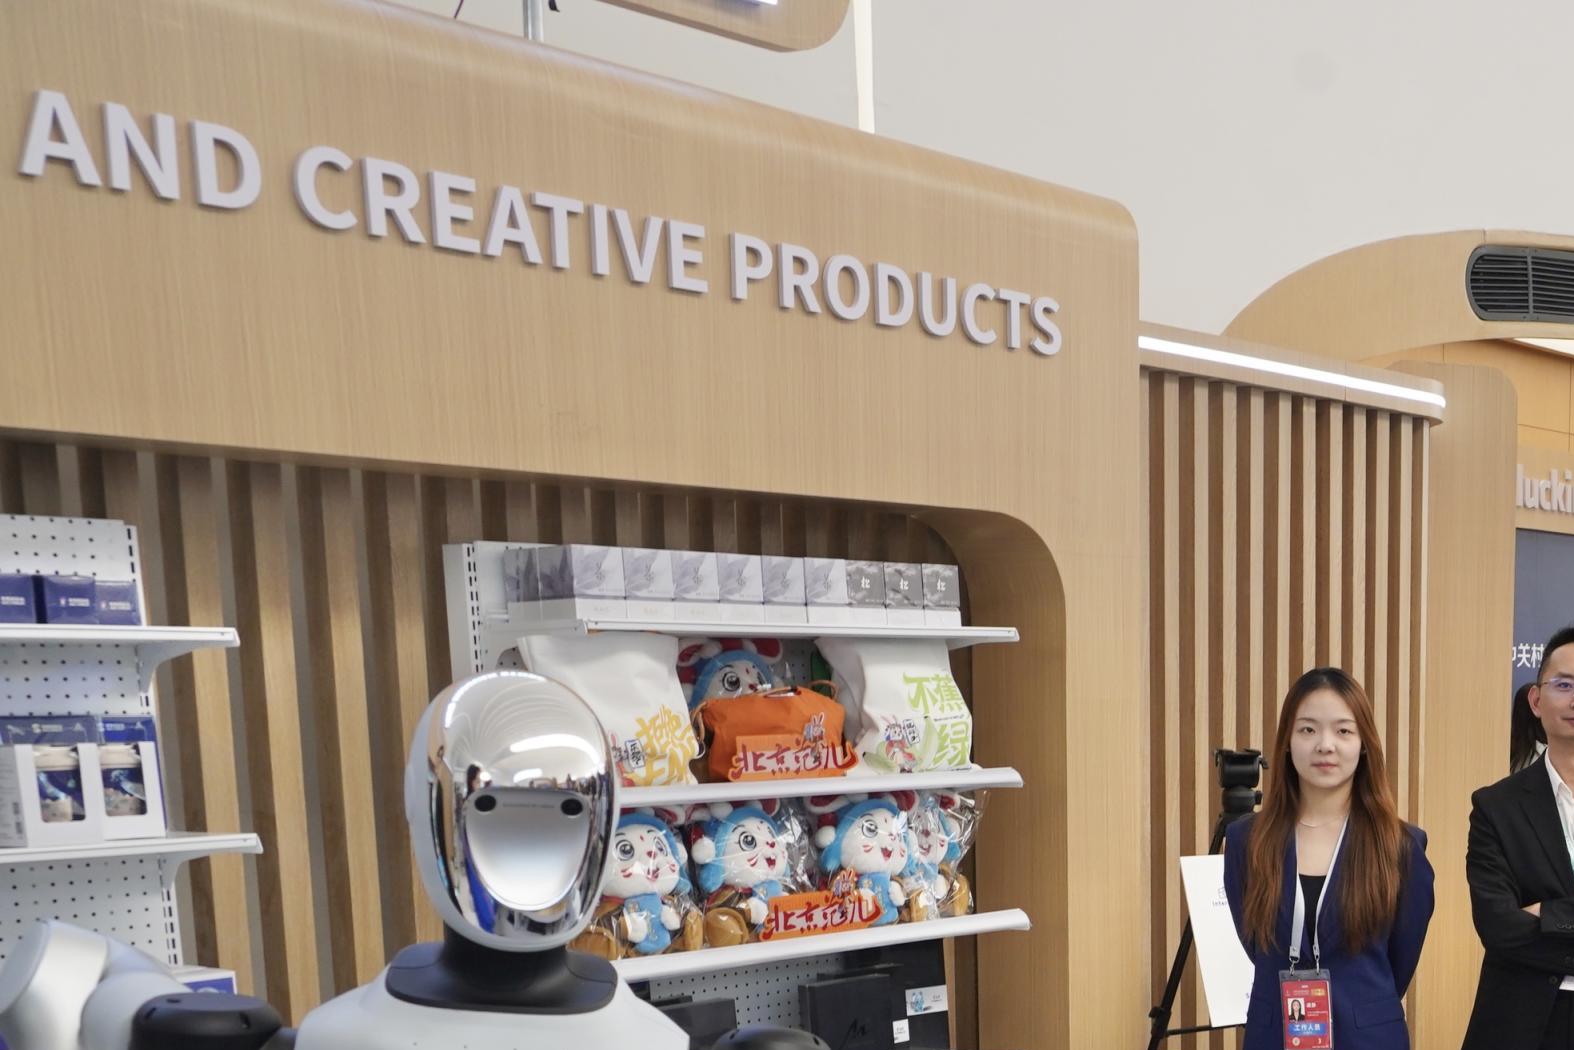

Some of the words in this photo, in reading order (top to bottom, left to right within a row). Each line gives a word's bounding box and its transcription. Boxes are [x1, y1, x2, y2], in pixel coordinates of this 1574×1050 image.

[18, 89, 263, 212] AND
[293, 145, 710, 296] CREATIVE
[728, 232, 1064, 358] PRODUCTS
